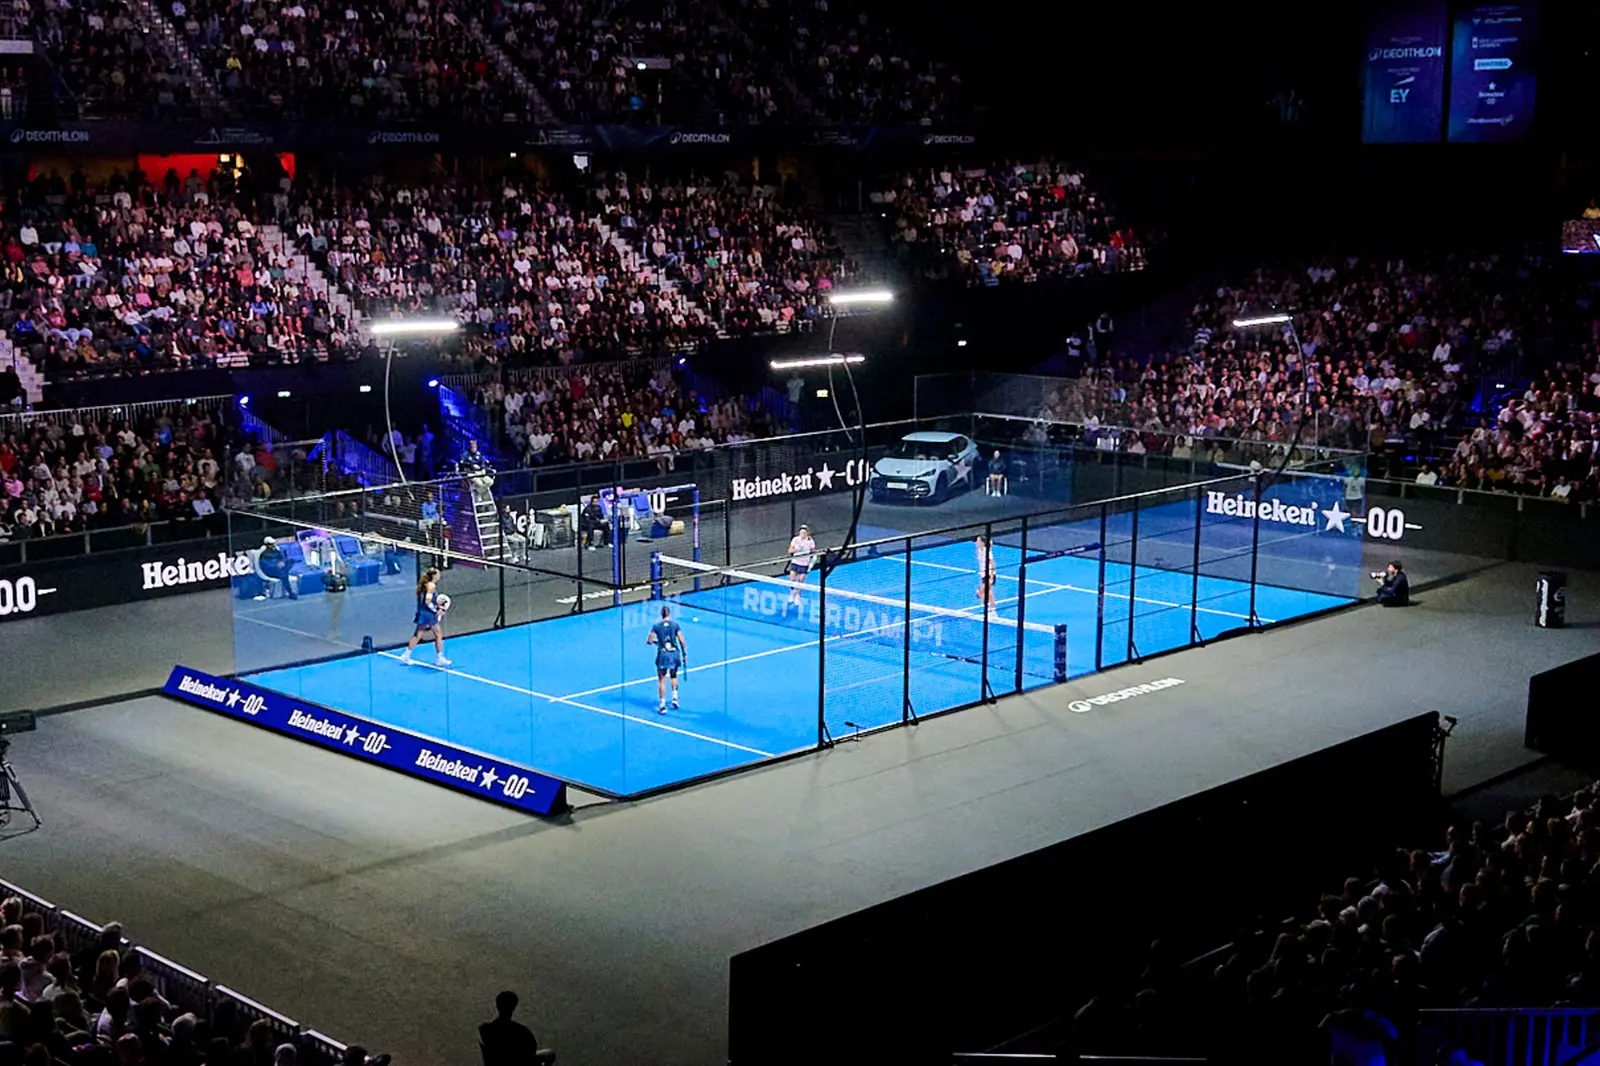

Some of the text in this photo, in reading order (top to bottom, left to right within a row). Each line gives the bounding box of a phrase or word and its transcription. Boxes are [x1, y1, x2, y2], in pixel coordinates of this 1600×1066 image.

[1383, 46, 1442, 59] DECATHLON
[1390, 88, 1410, 103] EY
[25, 130, 90, 142] DECATHLON
[382, 131, 440, 143] DECATHLON
[682, 132, 730, 143] DECATHLON
[732, 469, 813, 500] Heineken
[1206, 491, 1317, 526] Heineken
[743, 586, 905, 640] ROTTERDAM
[178, 675, 229, 703] Heineken
[288, 709, 347, 740] Heineken
[415, 748, 482, 783] Heineken
